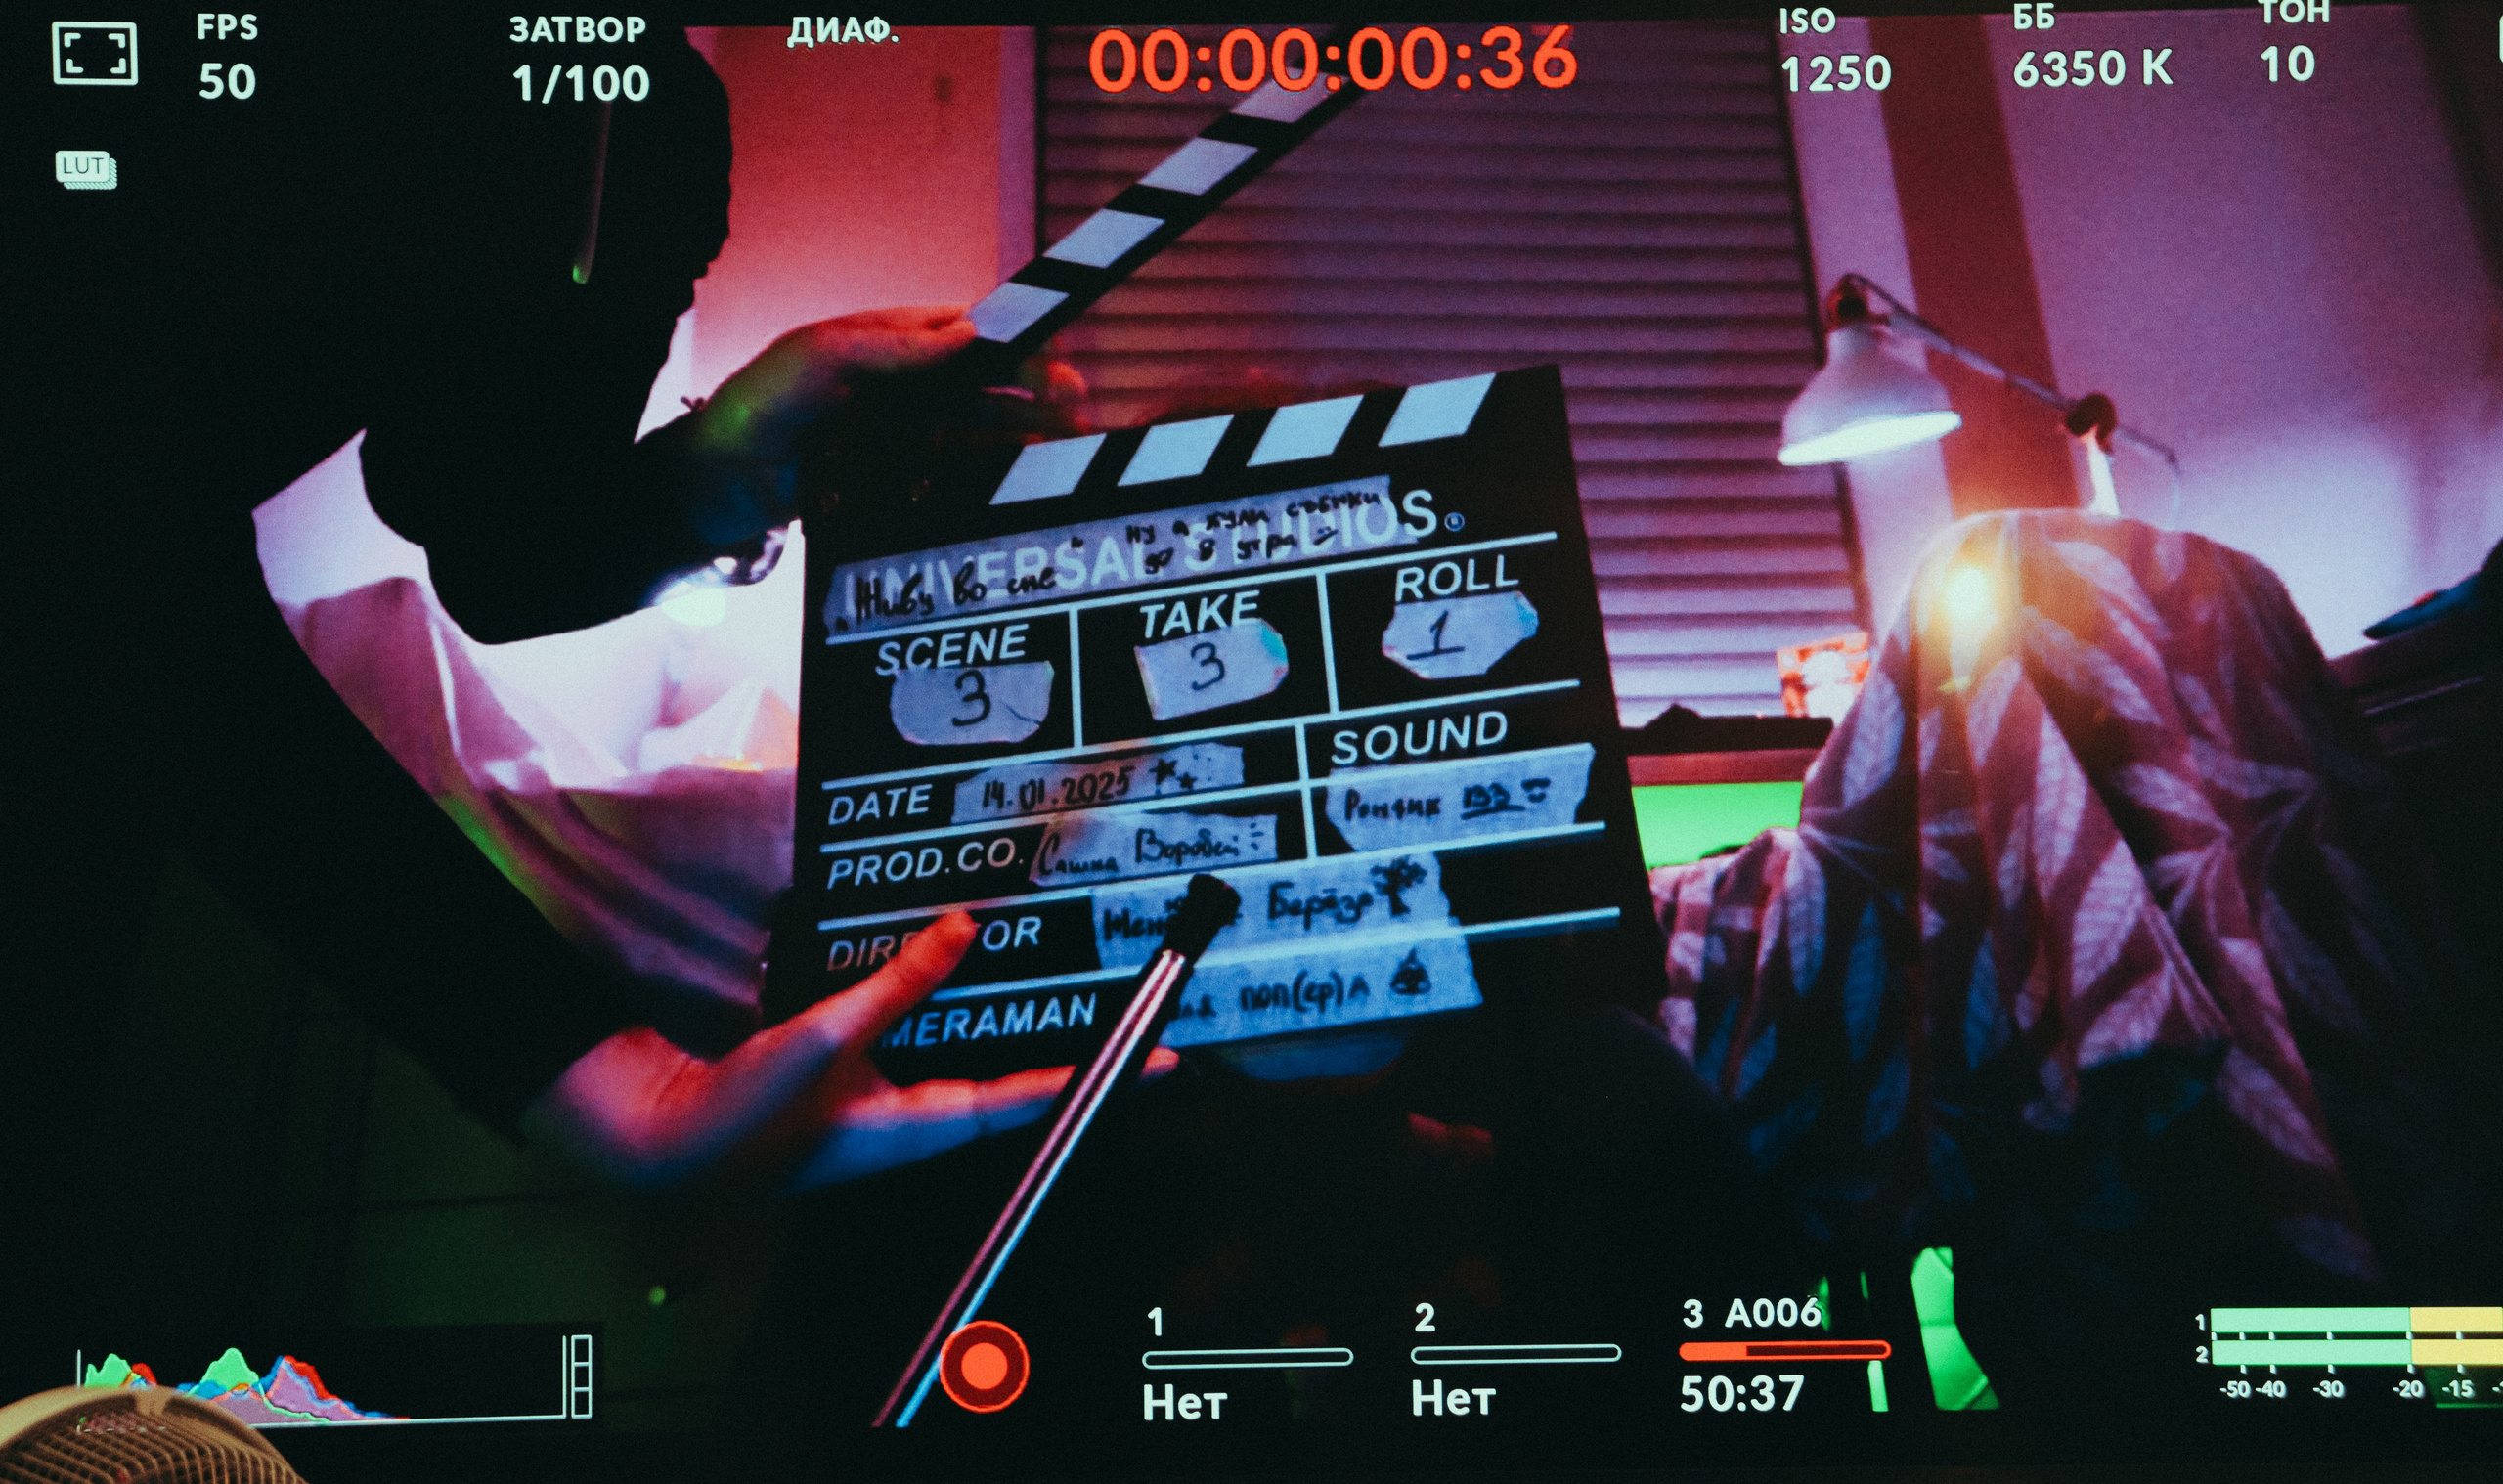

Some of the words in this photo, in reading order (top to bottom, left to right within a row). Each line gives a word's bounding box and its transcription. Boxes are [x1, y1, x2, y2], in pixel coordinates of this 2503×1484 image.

[198, 13, 258, 40] FPS
[509, 16, 646, 43] ЗАТВОР
[1779, 7, 1836, 34] ISO
[2013, 3, 2055, 30] ББ
[2258, 0, 2331, 24] ТОН
[787, 16, 900, 48] ДИАФ.
[1089, 25, 1577, 94] 00:00:00:36
[1781, 55, 1892, 92] 1250
[2013, 50, 2126, 87] 6350
[2261, 45, 2315, 82] 10
[199, 63, 256, 100] 50
[513, 65, 650, 104] 1/100
[63, 156, 105, 174] LUT
[1395, 554, 1519, 602] ROLL
[1139, 589, 1259, 638] TAKE
[875, 624, 1029, 676] SCENE
[1406, 609, 1465, 661] 1
[1191, 642, 1225, 691] 3
[952, 670, 991, 726] 3
[1331, 711, 1508, 764] SOUND
[828, 784, 932, 825] DATE
[982, 766, 1134, 810] 14.01.2025
[827, 837, 1025, 890] PROD.CO.
[827, 916, 1042, 971] DIROR
[882, 993, 1096, 1049] MERAMAN
[1148, 1307, 1162, 1336] 1
[1415, 1302, 1435, 1331] 2
[1683, 1298, 1703, 1328] 3
[1725, 1297, 1822, 1328] A006
[2195, 1313, 2206, 1331] 1
[2195, 1346, 2209, 1364] 2
[1144, 1383, 1228, 1420] Нет
[1412, 1379, 1497, 1417] Нет
[1680, 1375, 1804, 1413] 50:37
[2219, 1380, 2252, 1398] -50
[2255, 1380, 2287, 1398] -40
[2312, 1380, 2345, 1398] -30
[2392, 1380, 2425, 1398] -20
[2441, 1379, 2475, 1398] -15
